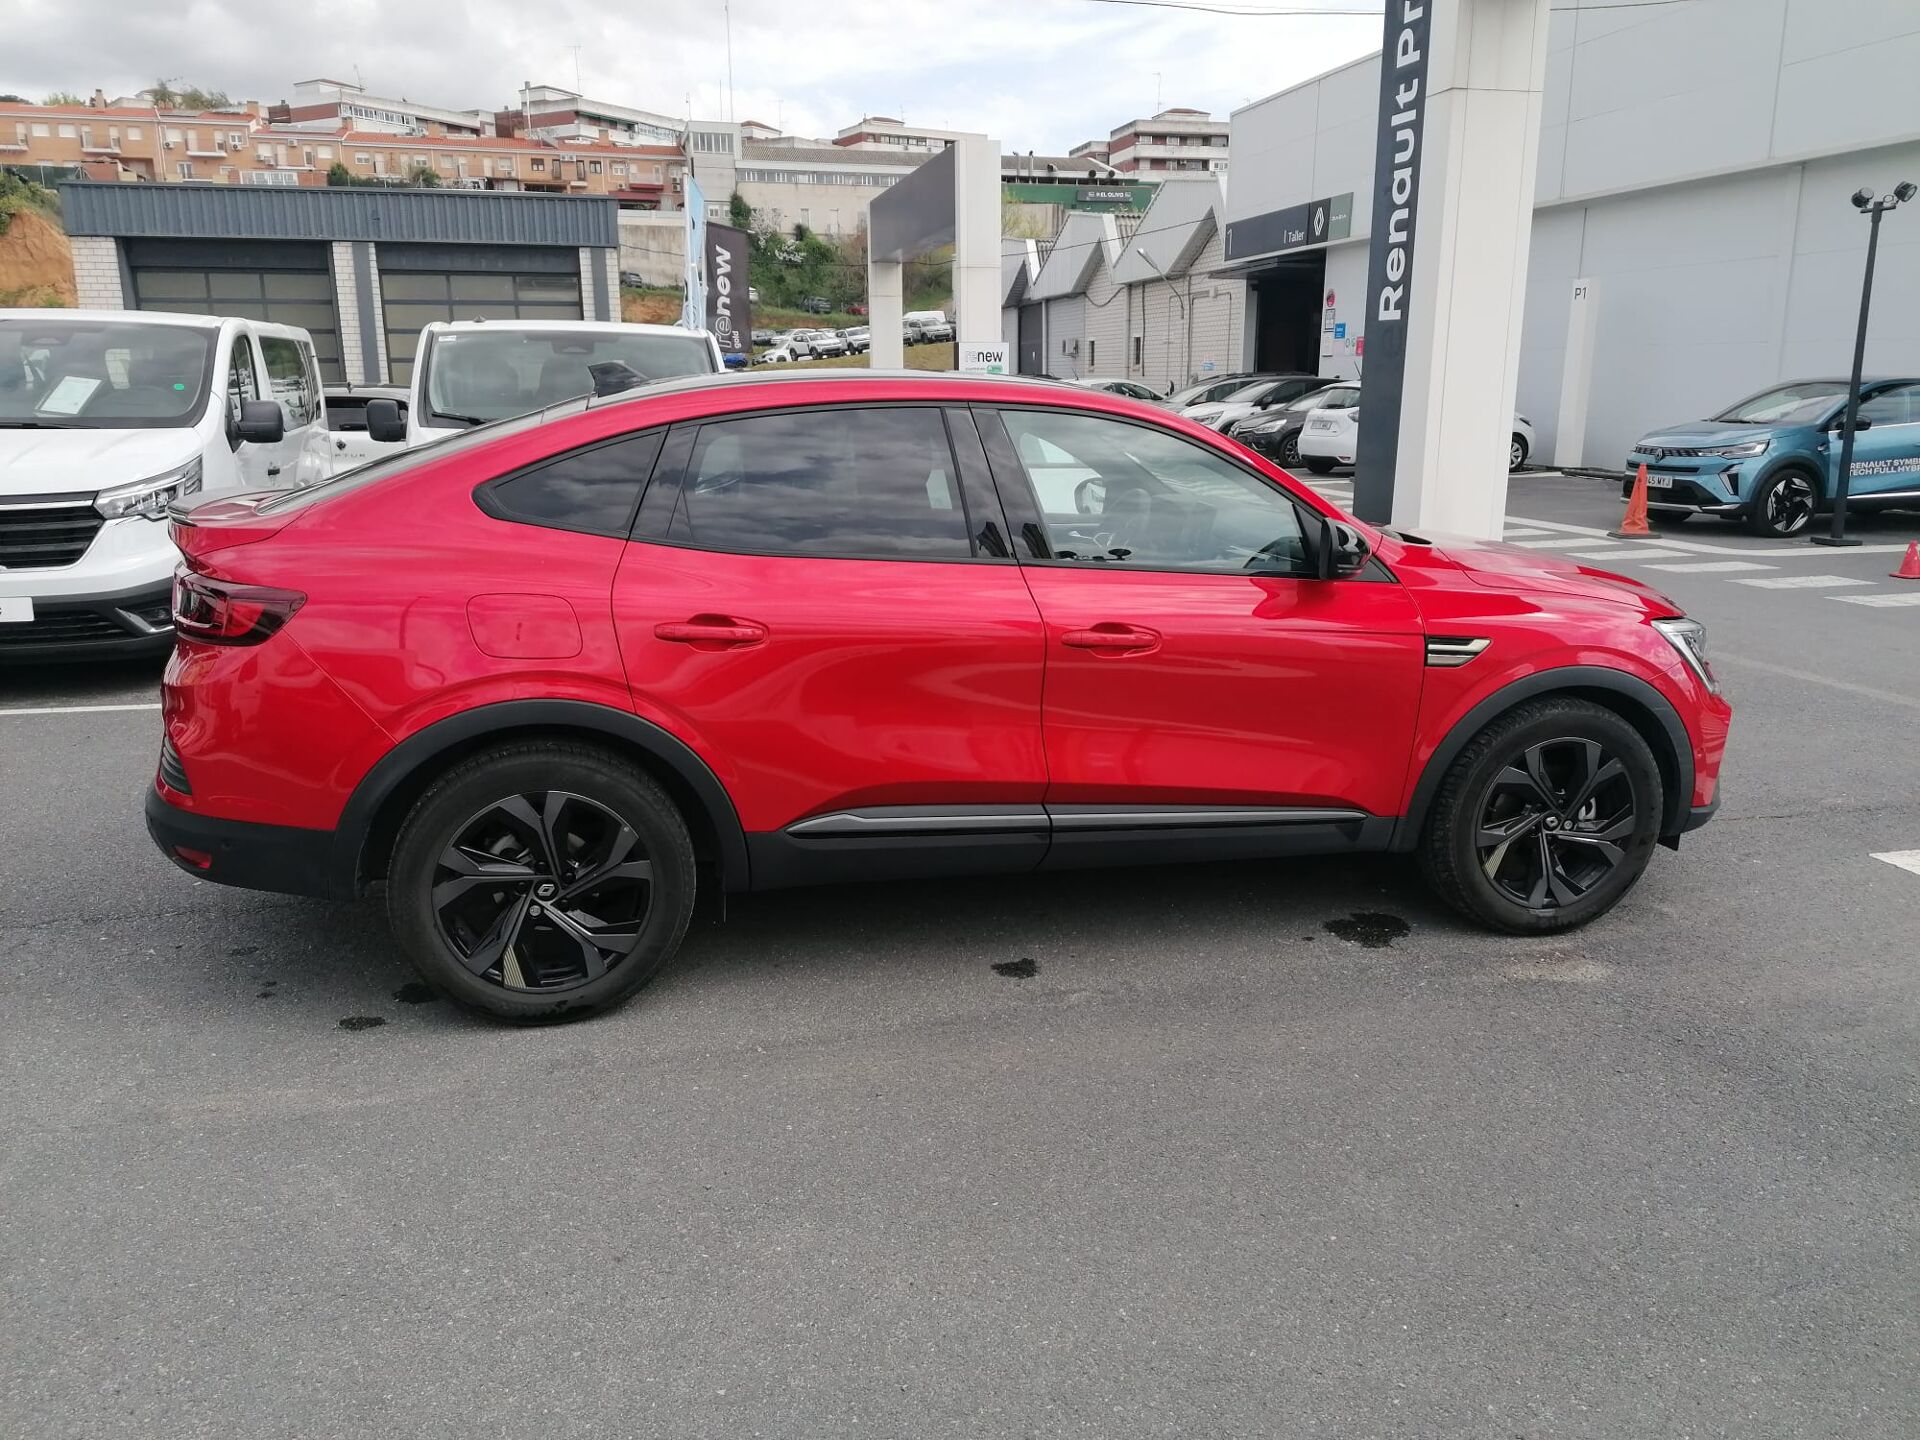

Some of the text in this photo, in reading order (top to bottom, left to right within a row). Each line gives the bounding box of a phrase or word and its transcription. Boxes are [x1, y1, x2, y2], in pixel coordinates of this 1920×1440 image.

[1378, 78, 1419, 321] Renault
[1288, 229, 1305, 243] Taller
[715, 244, 732, 349] renew
[1574, 287, 1587, 300] P1
[732, 330, 741, 348] gold
[1850, 459, 1892, 470] RENAULT
[1850, 467, 1873, 477] TECH
[1873, 465, 1897, 474] FULL
